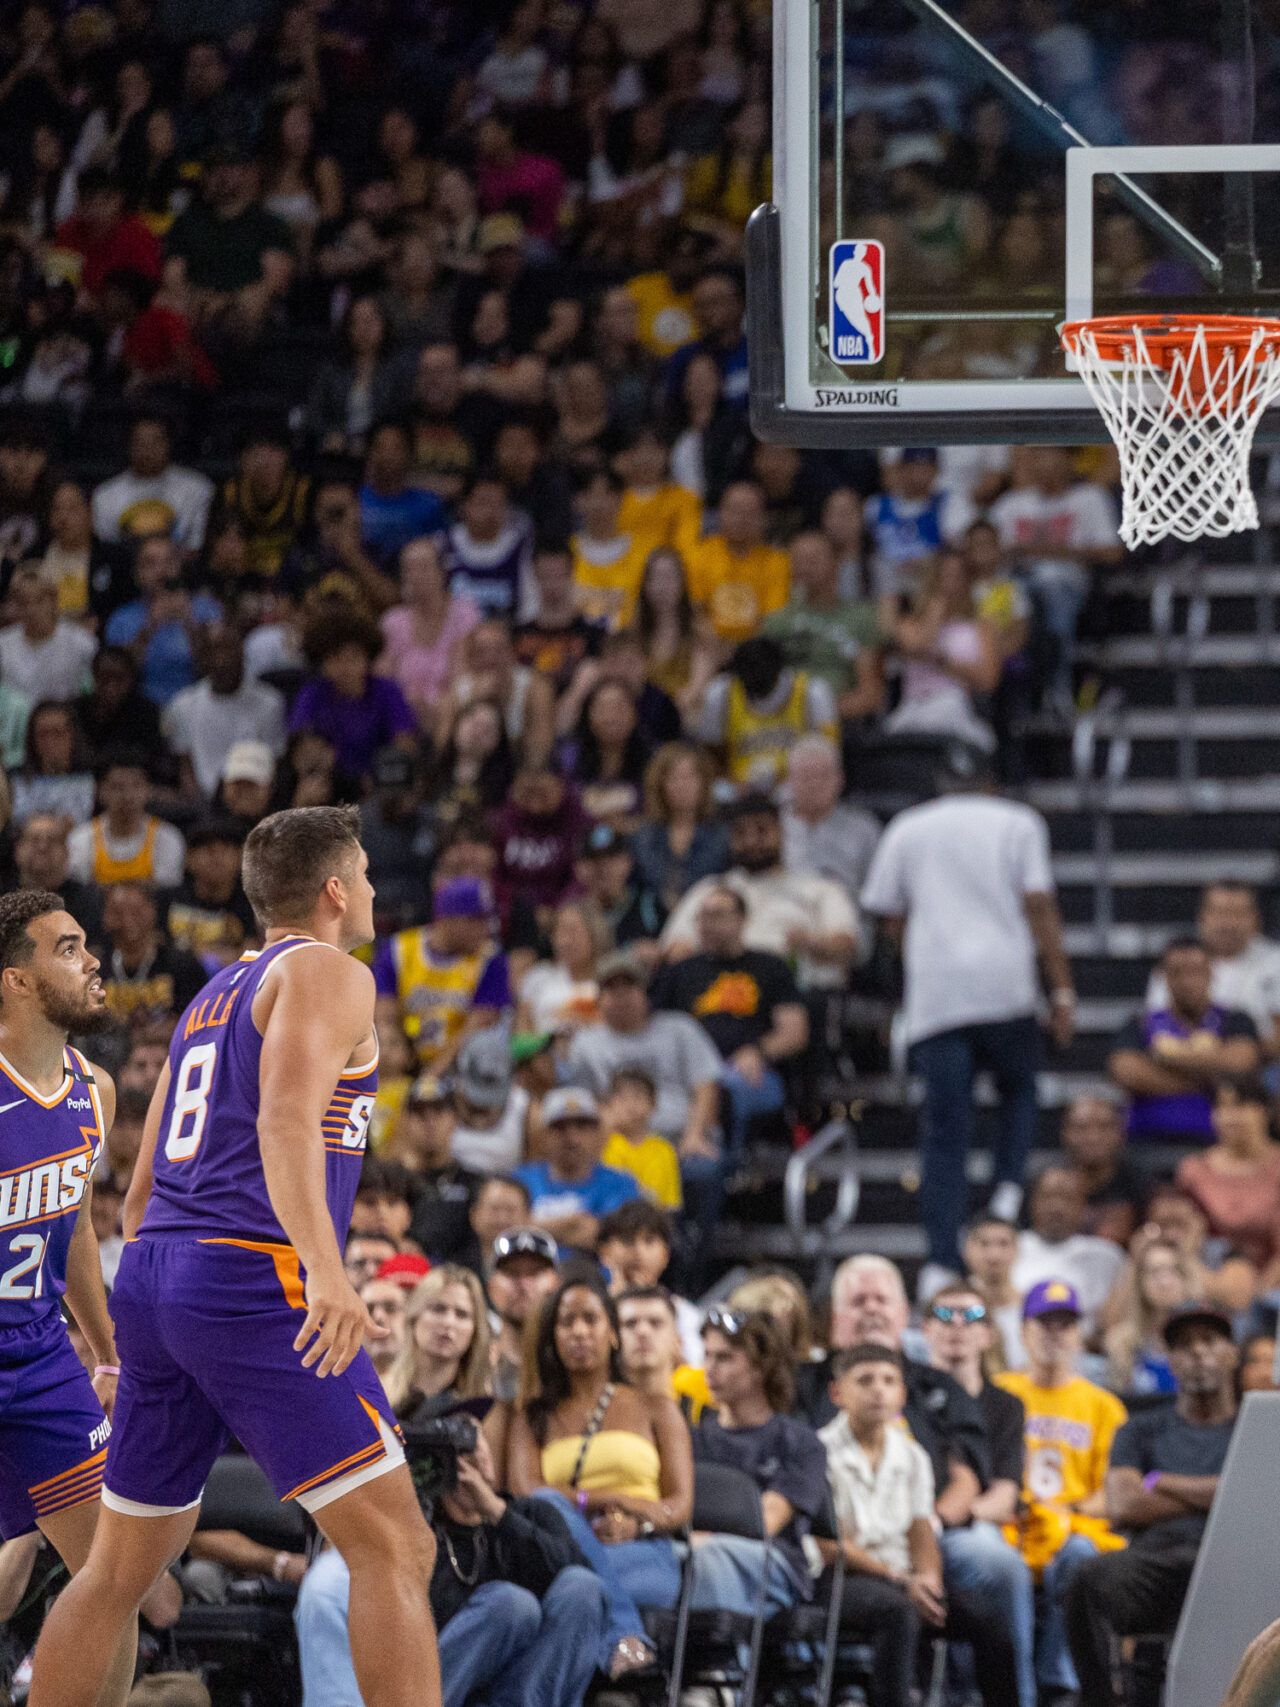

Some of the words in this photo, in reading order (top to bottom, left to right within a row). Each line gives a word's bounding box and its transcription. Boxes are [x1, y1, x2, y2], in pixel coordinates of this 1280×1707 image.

[837, 335, 864, 356] NBA
[815, 389, 899, 408] SPALDING
[66, 1097, 92, 1112] PayPal
[164, 1041, 218, 1163] 8
